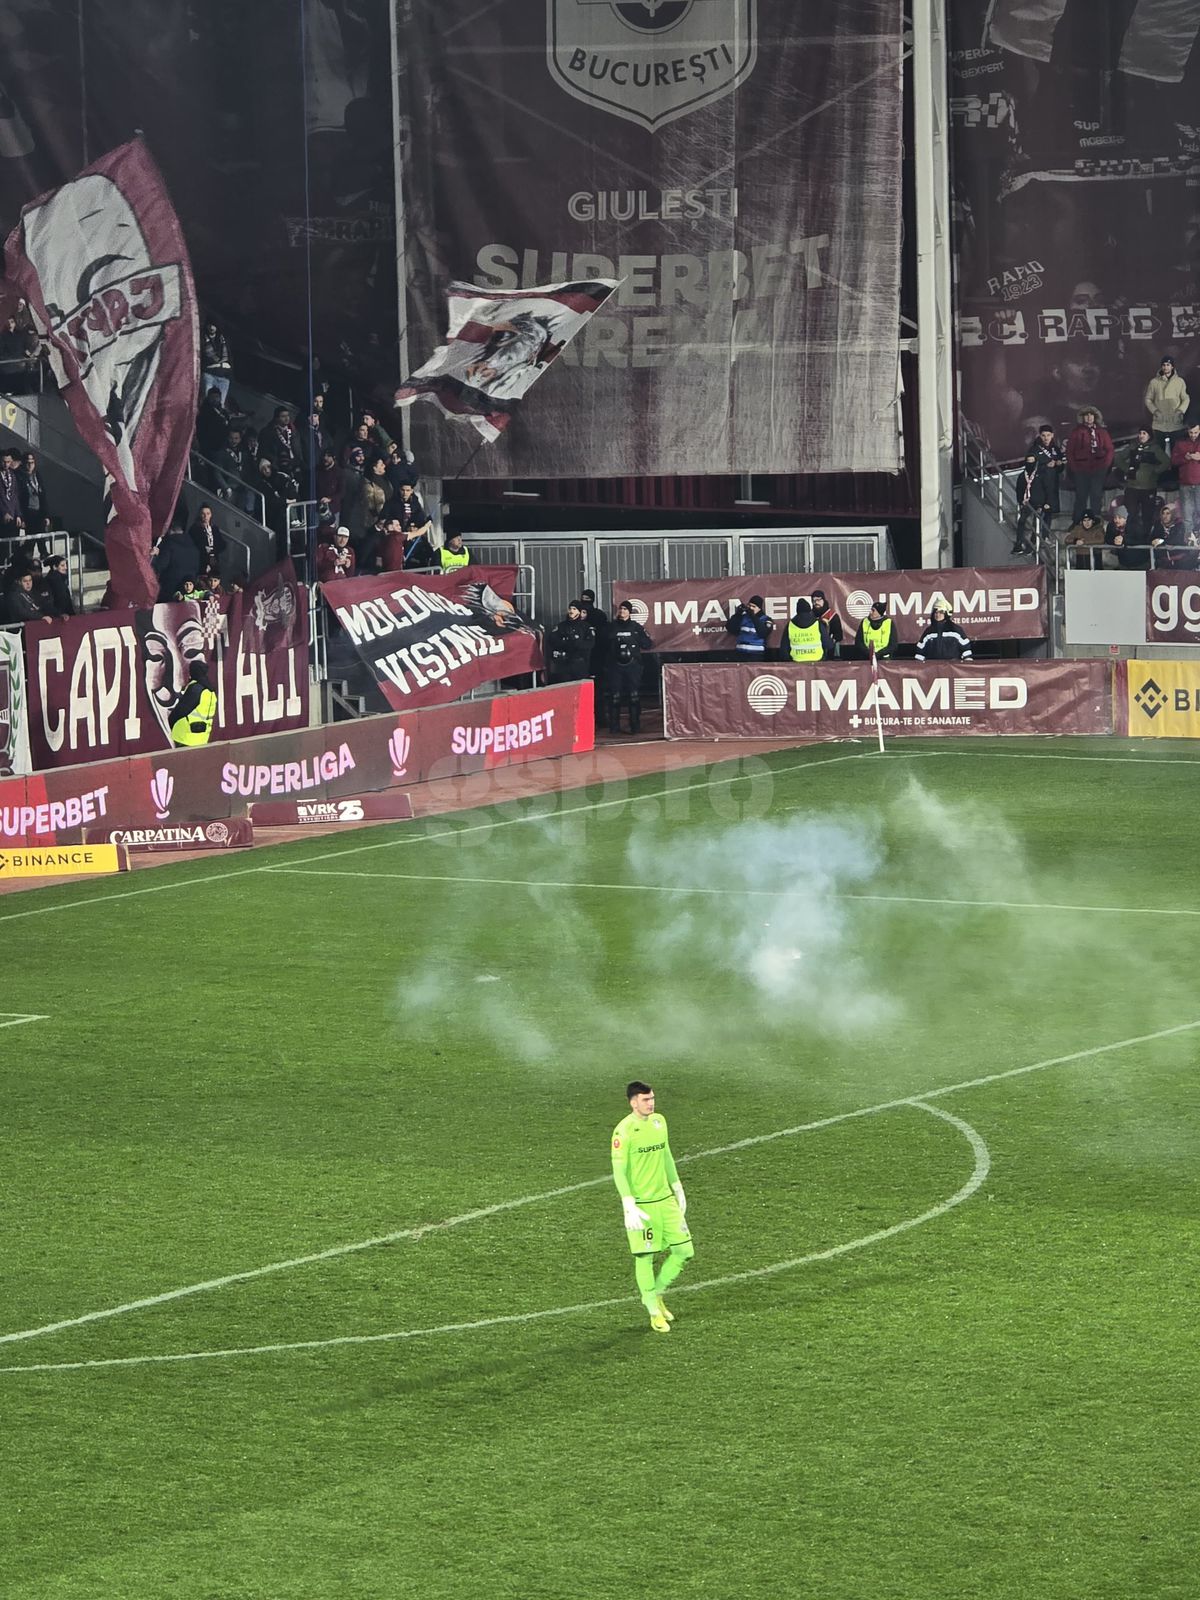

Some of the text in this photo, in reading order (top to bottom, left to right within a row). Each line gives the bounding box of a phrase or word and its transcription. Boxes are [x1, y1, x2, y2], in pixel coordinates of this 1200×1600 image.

[568, 43, 733, 87] BUCUREȘTI
[568, 187, 738, 231] GIULEȘTI
[474, 233, 829, 309] SUPERBET
[986, 259, 1046, 296] RAPID
[1001, 273, 1043, 302] 1923
[1037, 307, 1162, 344] RAPID
[796, 677, 1028, 711] IMAMED
[451, 709, 555, 755] SUPERBET
[914, 717, 926, 725] DE
[927, 717, 971, 725] SANATATE
[221, 742, 356, 797] SUPERLIGA
[0, 785, 109, 837] UPERBET
[338, 799, 365, 821] 25
[109, 825, 207, 845] CARPATINA
[13, 852, 94, 867] BINANCE
[642, 1228, 654, 1241] 16
